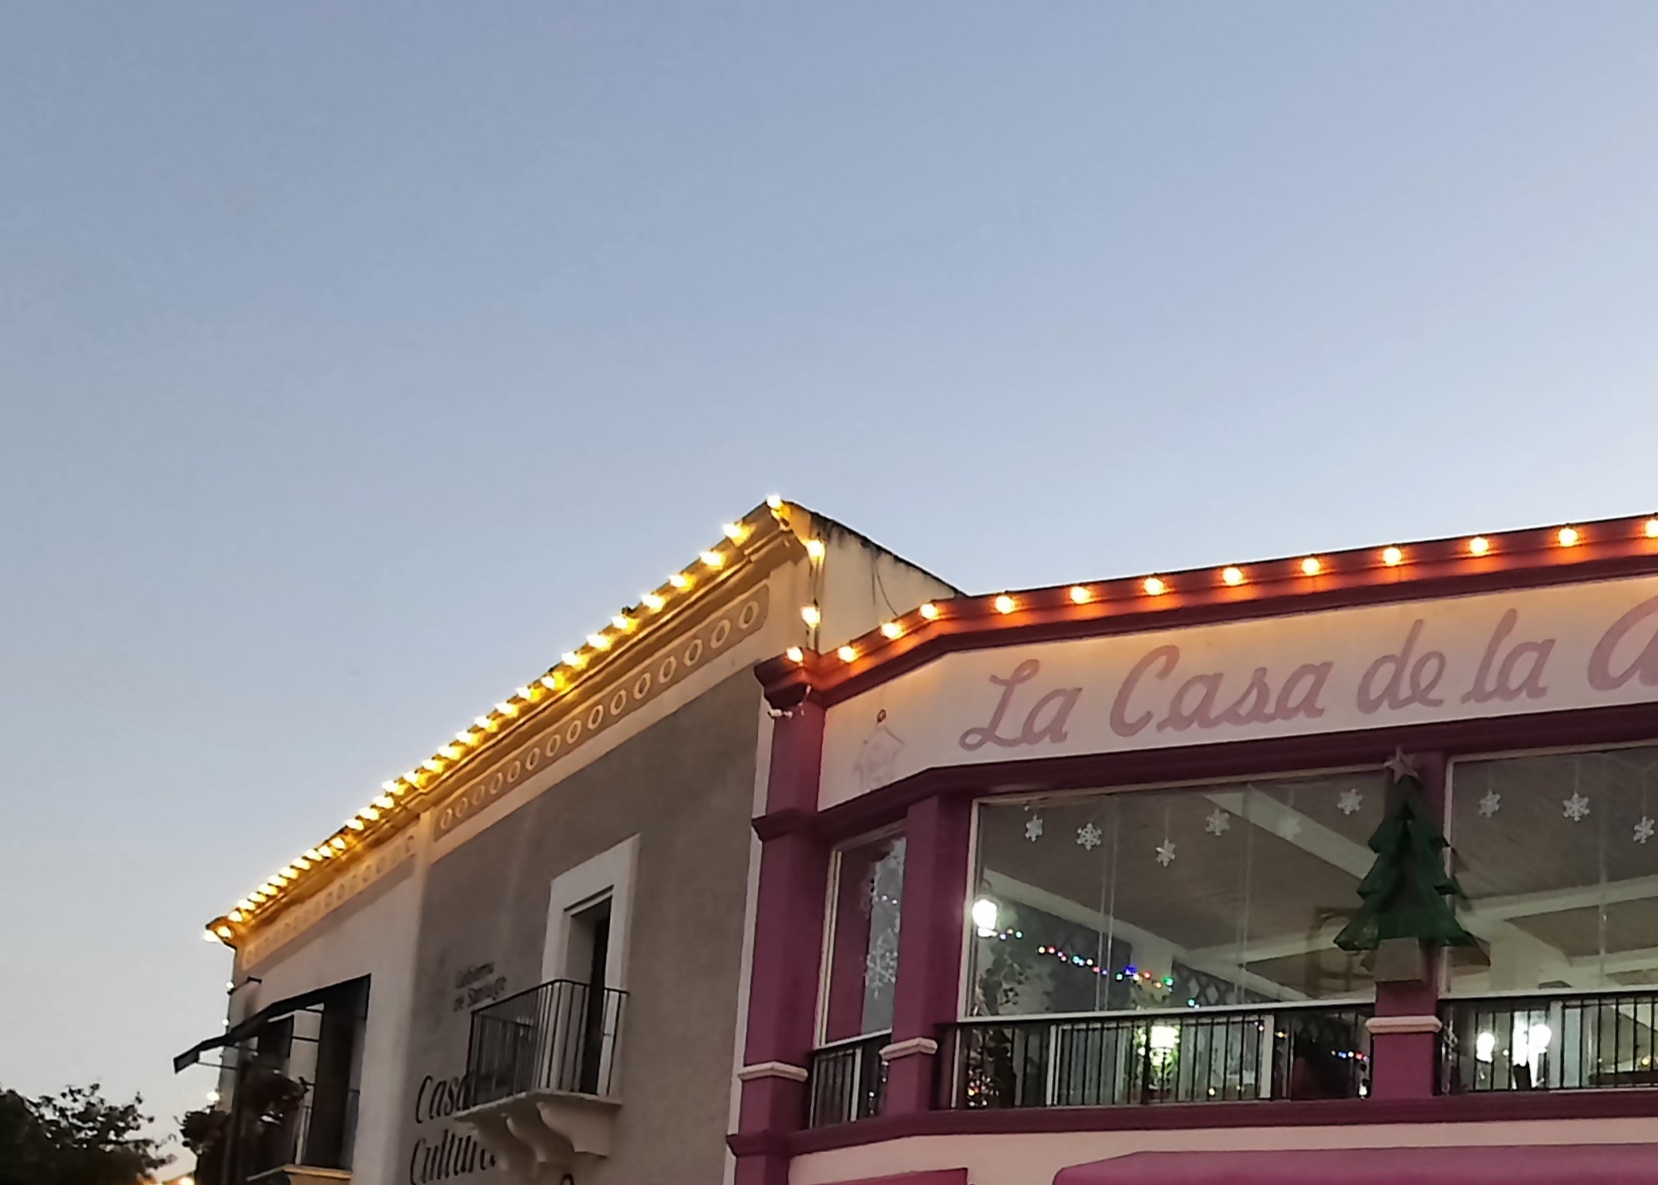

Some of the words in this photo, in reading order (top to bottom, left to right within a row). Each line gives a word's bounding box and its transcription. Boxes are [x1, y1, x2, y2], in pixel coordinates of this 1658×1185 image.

[958, 658, 1083, 751] La
[1109, 645, 1334, 737] Casa
[1356, 618, 1447, 714] de
[1459, 608, 1556, 704] la
